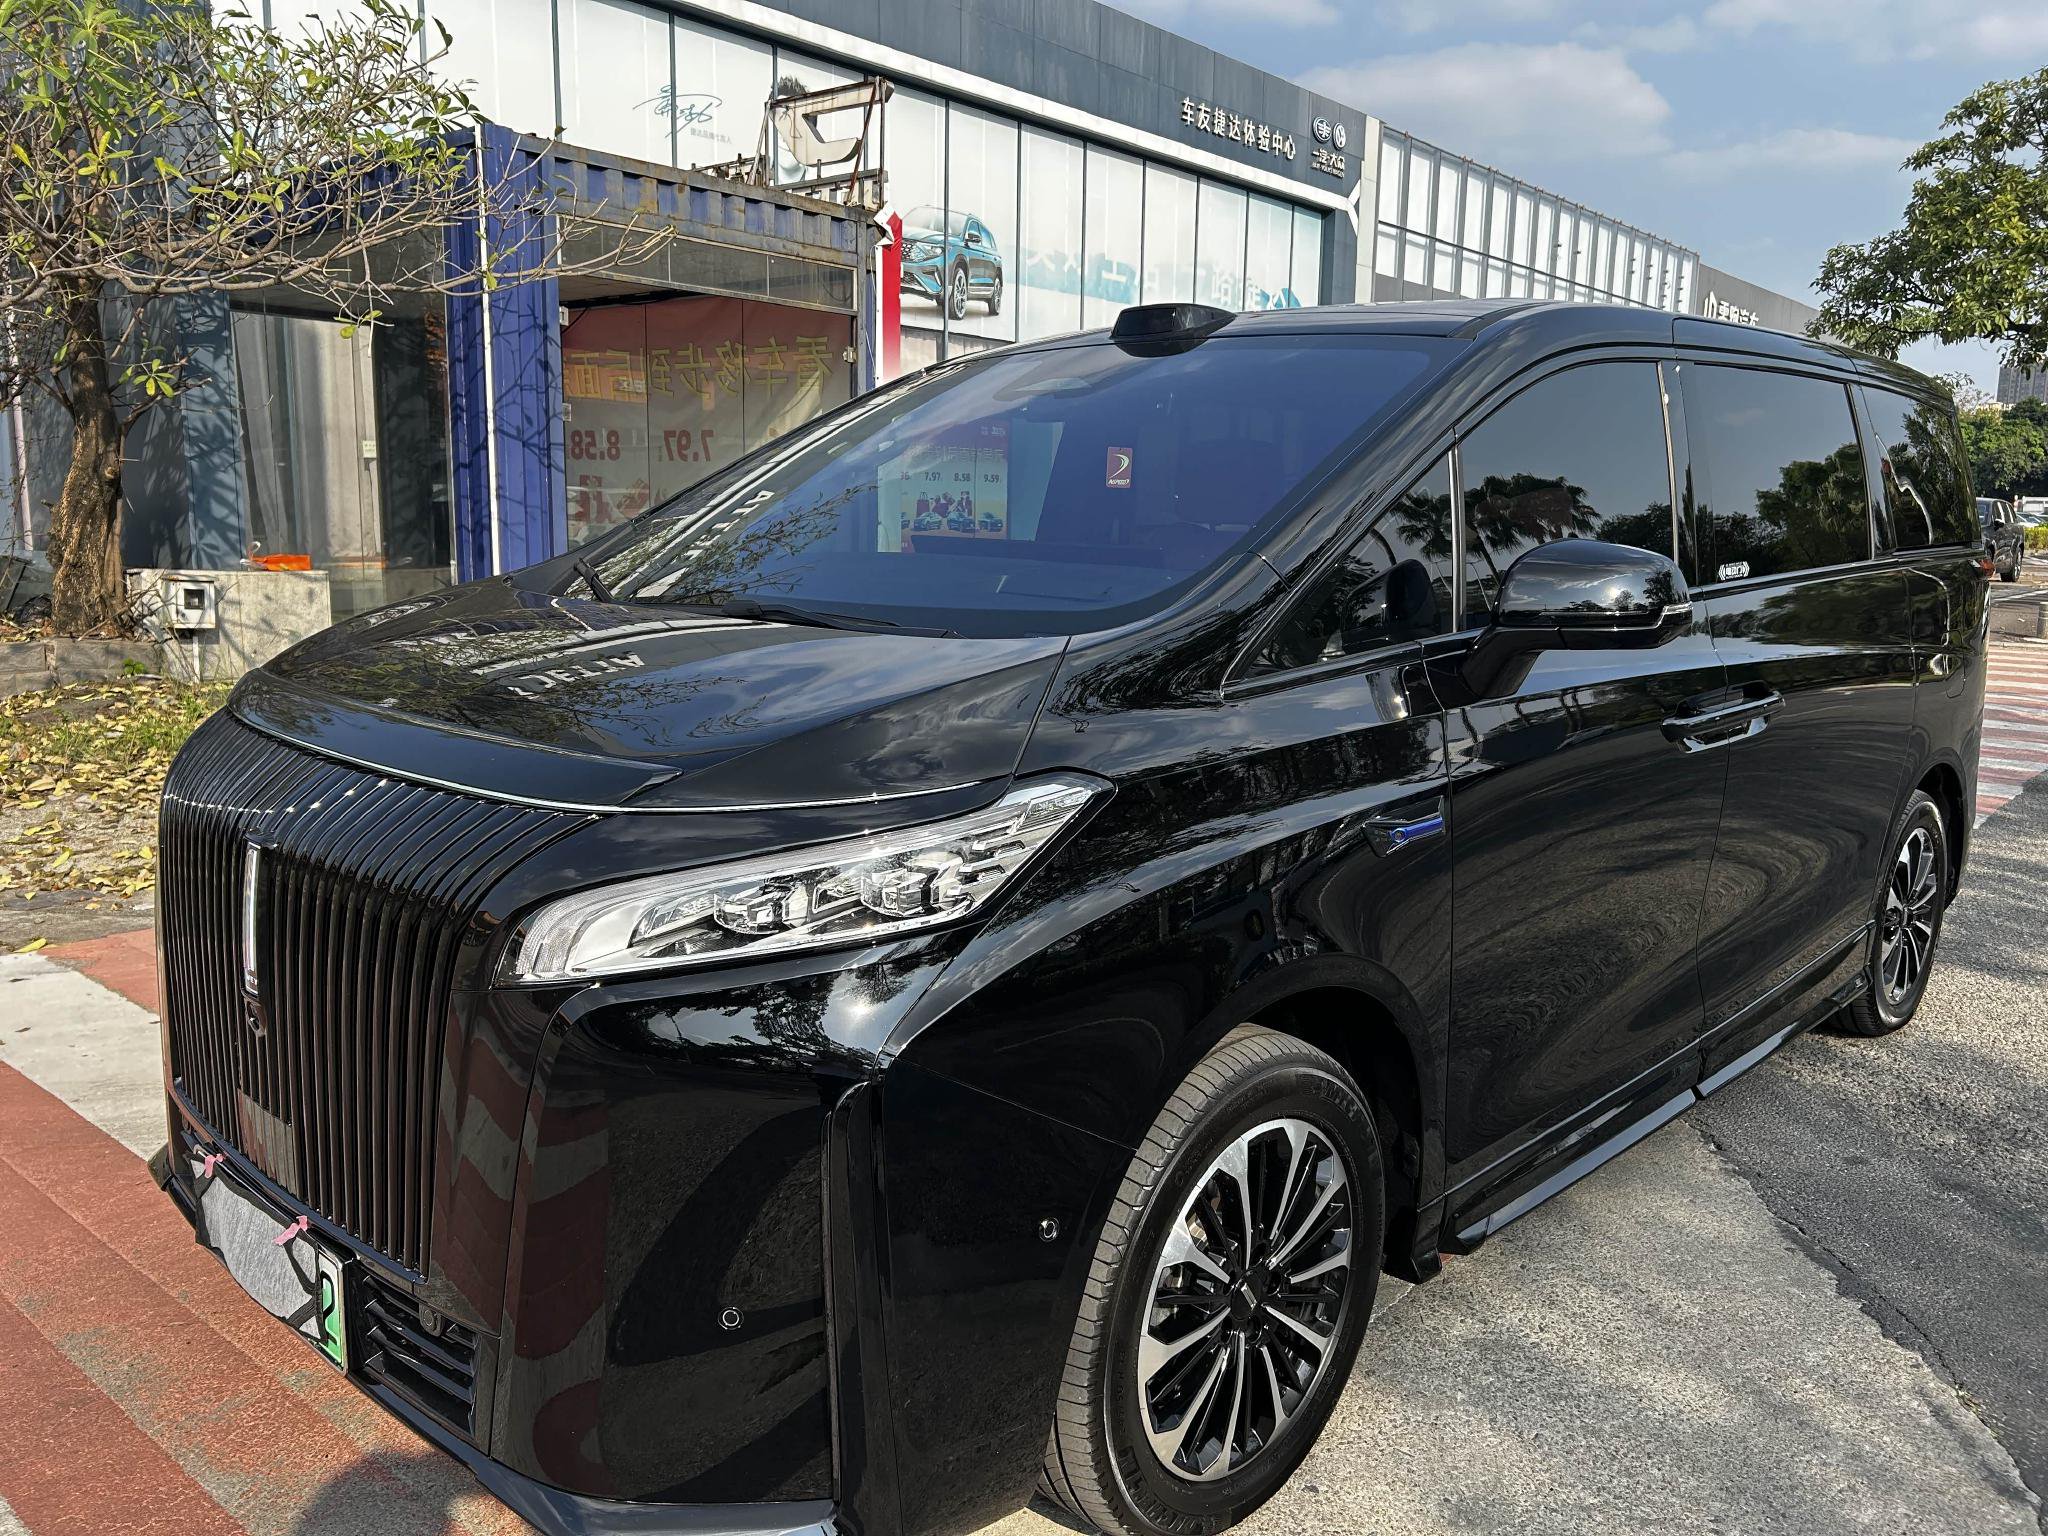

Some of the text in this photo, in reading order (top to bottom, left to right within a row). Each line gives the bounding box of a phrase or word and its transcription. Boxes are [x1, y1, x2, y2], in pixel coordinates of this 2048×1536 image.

[1182, 97, 1296, 160] 车友捷达体验中心
